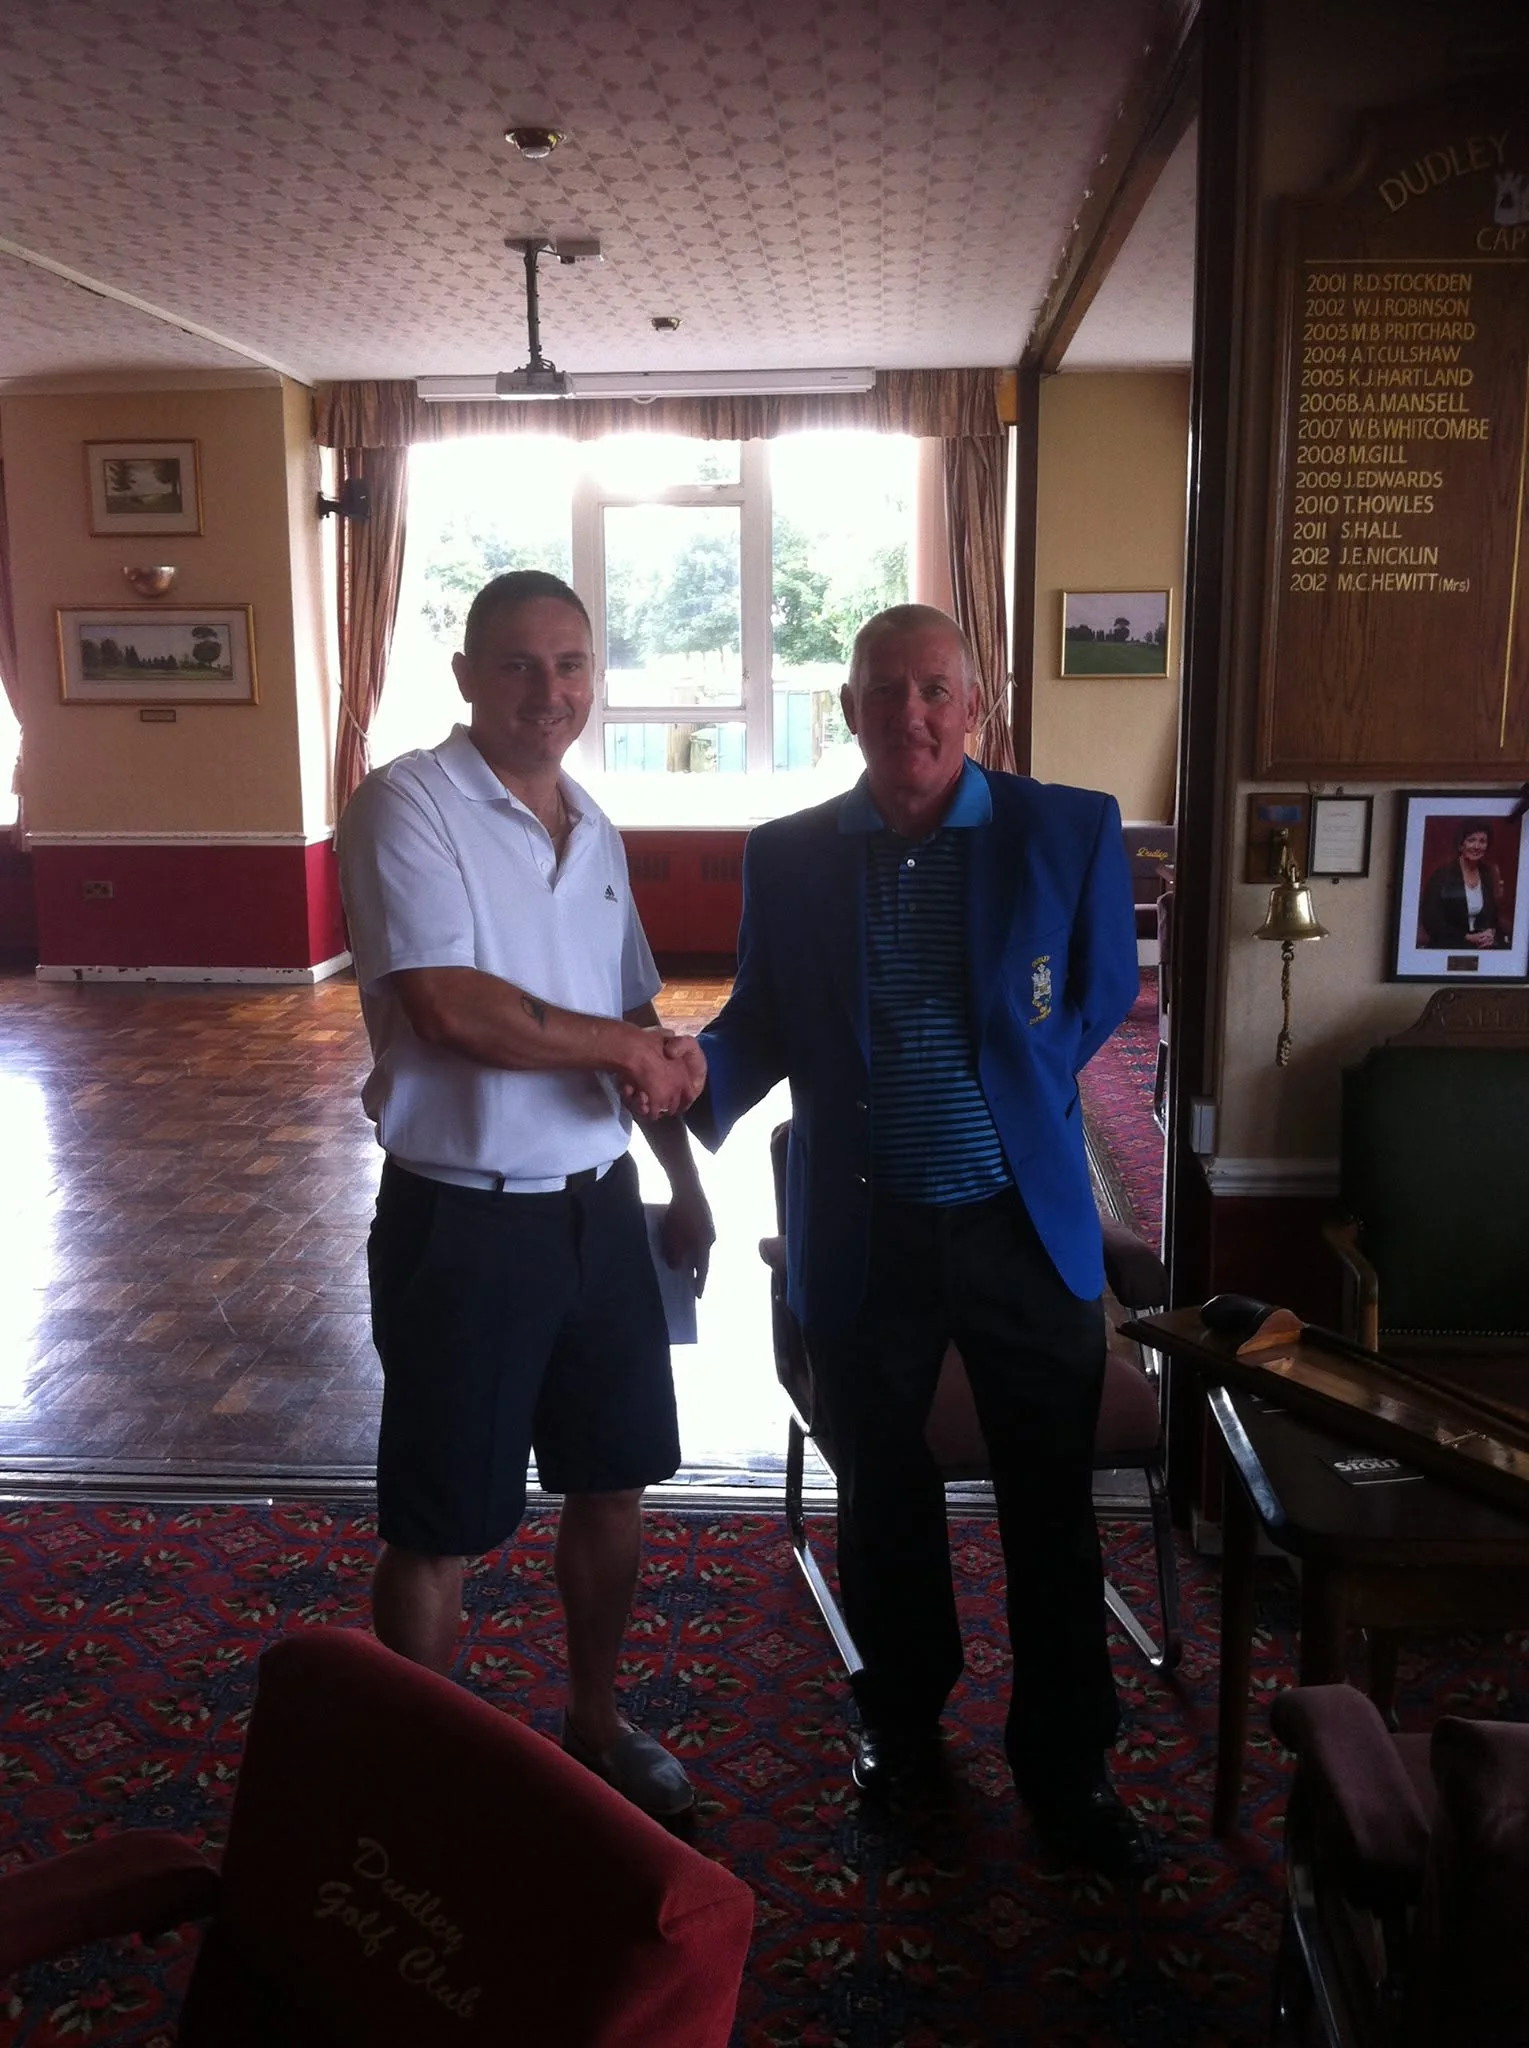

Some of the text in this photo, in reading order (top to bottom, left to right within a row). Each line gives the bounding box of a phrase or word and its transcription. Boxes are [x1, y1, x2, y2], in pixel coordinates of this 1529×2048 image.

[1378, 131, 1509, 212] DUDLEY
[1476, 227, 1529, 251] CAP
[1307, 273, 1346, 292] 2001
[1305, 299, 1345, 317] 2002
[1303, 323, 1349, 341] 2003
[1303, 346, 1346, 364] 2004
[1301, 369, 1345, 387] 2005
[1300, 393, 1347, 413] 2006
[1298, 418, 1343, 440] 2007
[1297, 445, 1346, 464] 2008
[1295, 472, 1342, 489] 2009
[1294, 495, 1339, 514] 2010
[1293, 522, 1327, 540] 2011
[1291, 548, 1330, 565] 2012
[1289, 573, 1327, 592] 2012
[352, 1836, 465, 1956] Dudley
[313, 1880, 483, 2019] Golf Club
